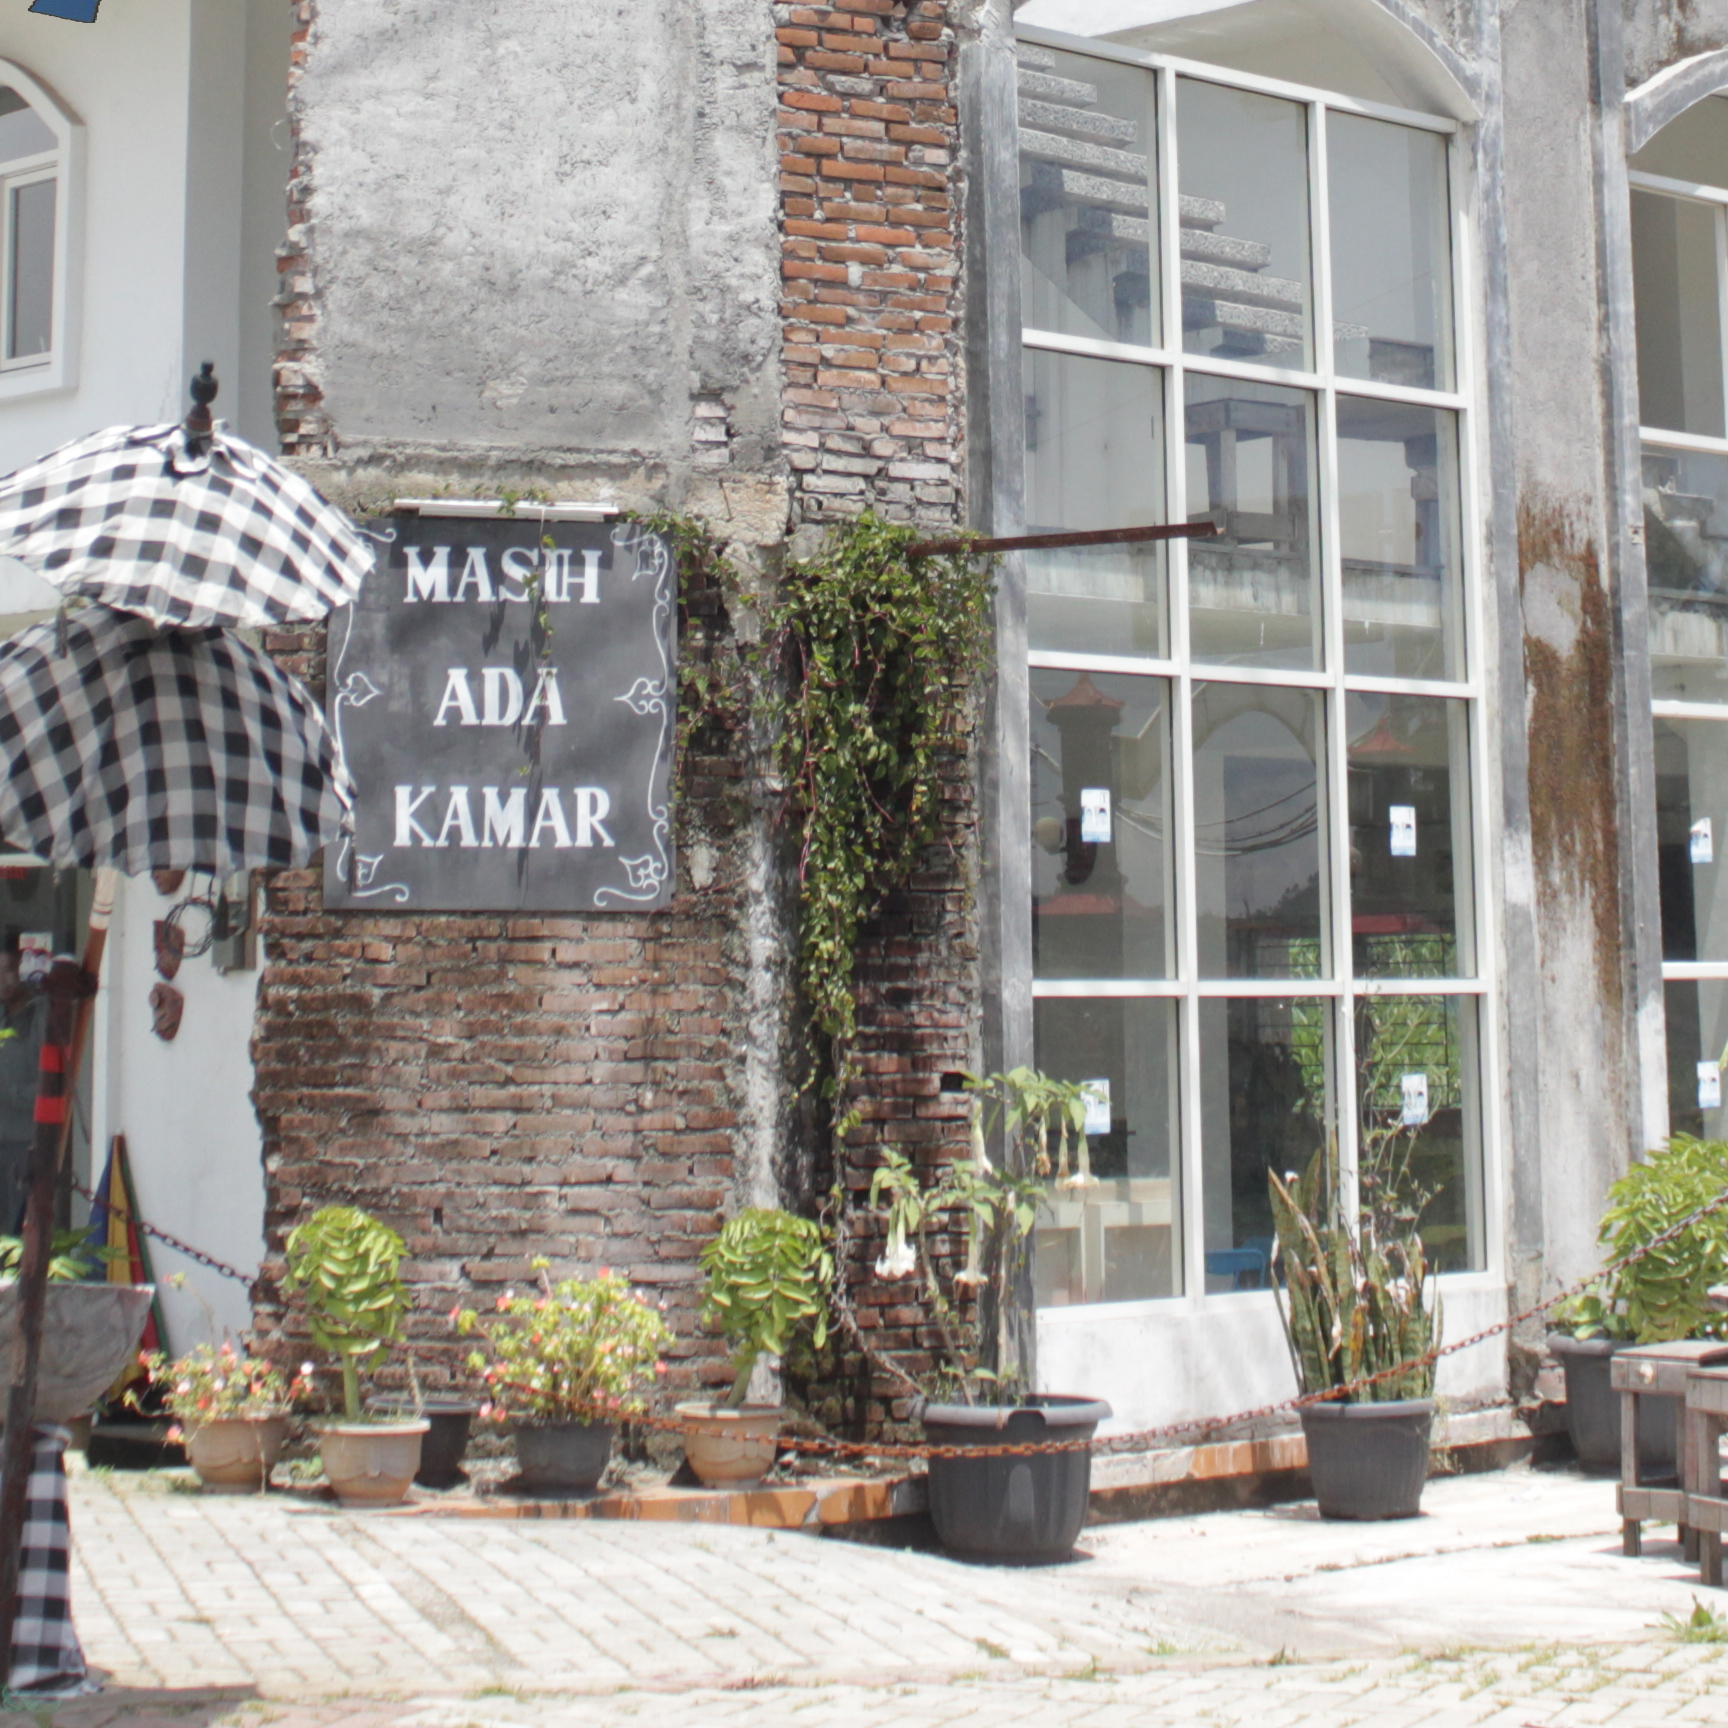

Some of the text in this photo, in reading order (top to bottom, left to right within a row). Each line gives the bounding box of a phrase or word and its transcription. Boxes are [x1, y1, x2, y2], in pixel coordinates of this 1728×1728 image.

[402, 545, 603, 604] MASIH
[433, 666, 568, 727] ADA
[392, 784, 616, 849] KAMAR
